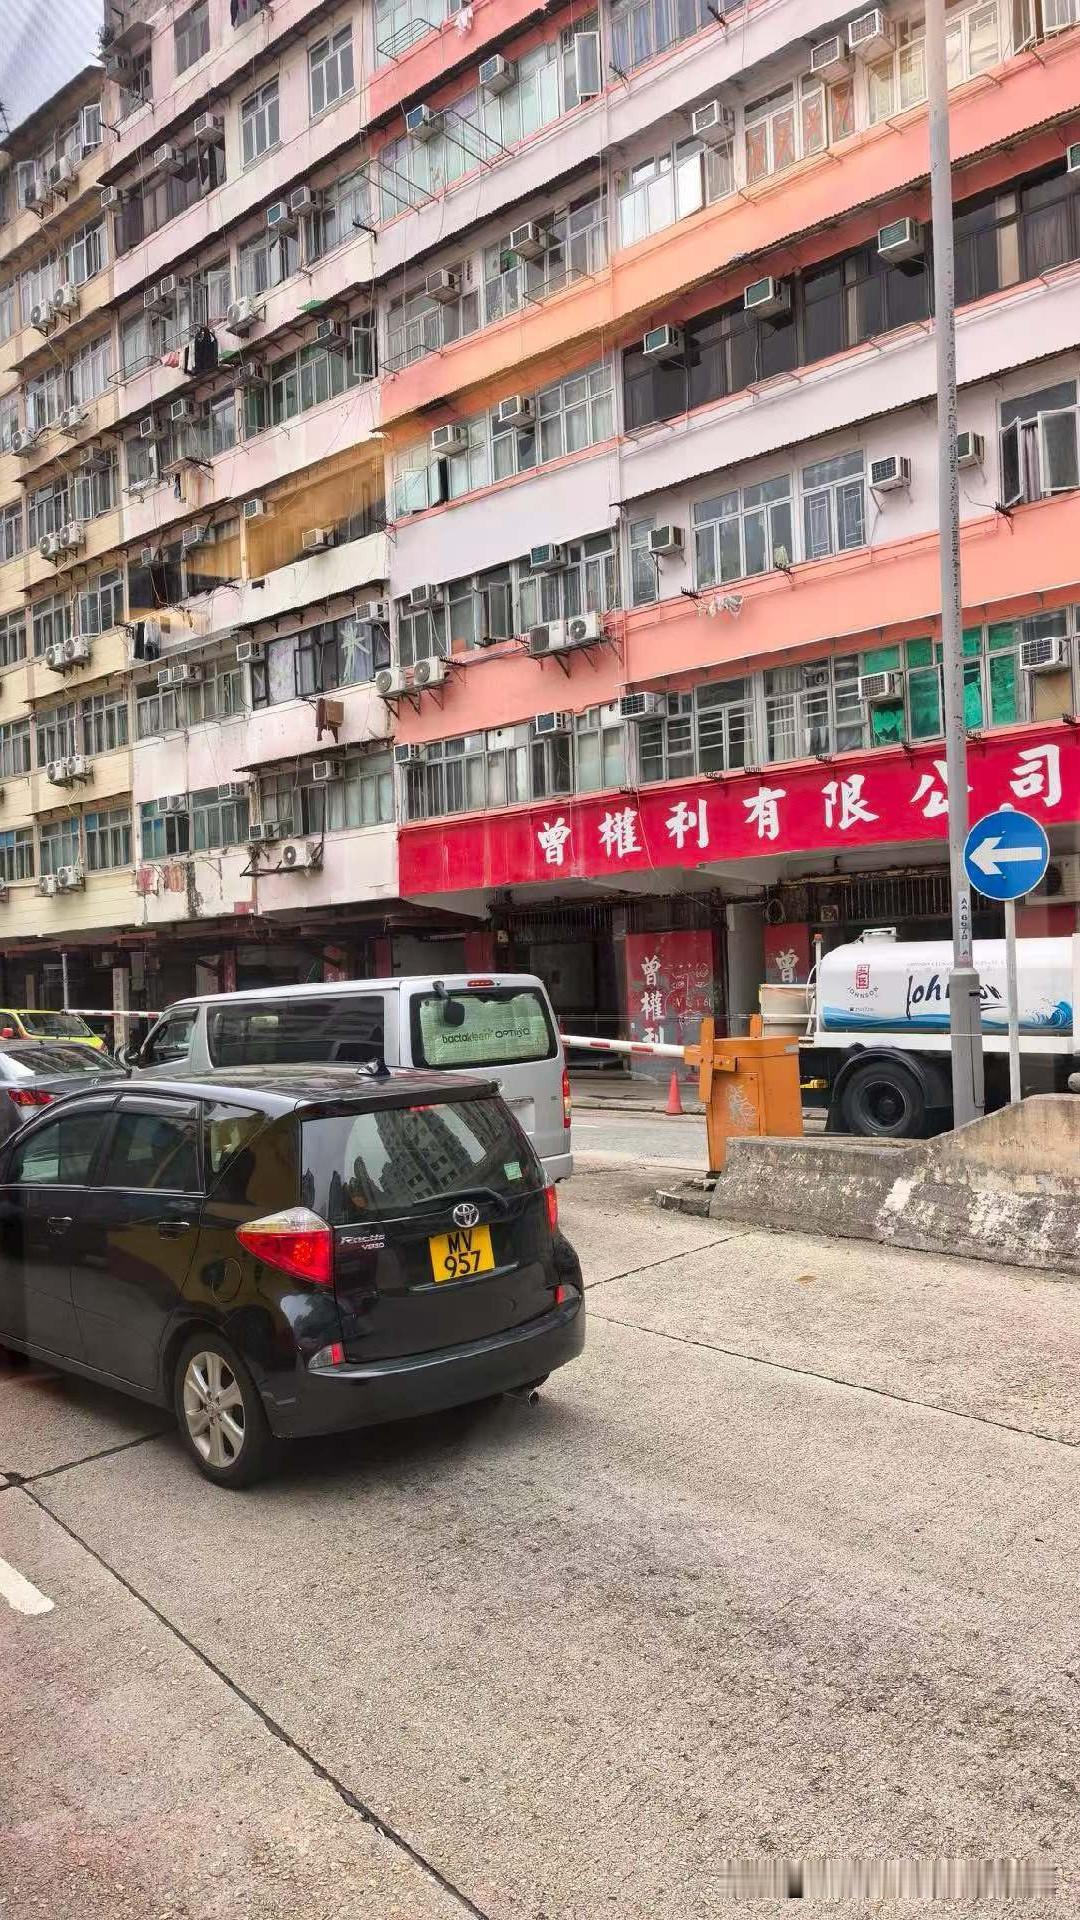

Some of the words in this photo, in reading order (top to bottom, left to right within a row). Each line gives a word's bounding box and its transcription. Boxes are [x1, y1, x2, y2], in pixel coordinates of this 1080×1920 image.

[537, 743, 1063, 866] 曾權利有限公司
[905, 974, 1002, 1021] Johon
[446, 1229, 473, 1255] MV
[444, 1250, 481, 1278] 957
